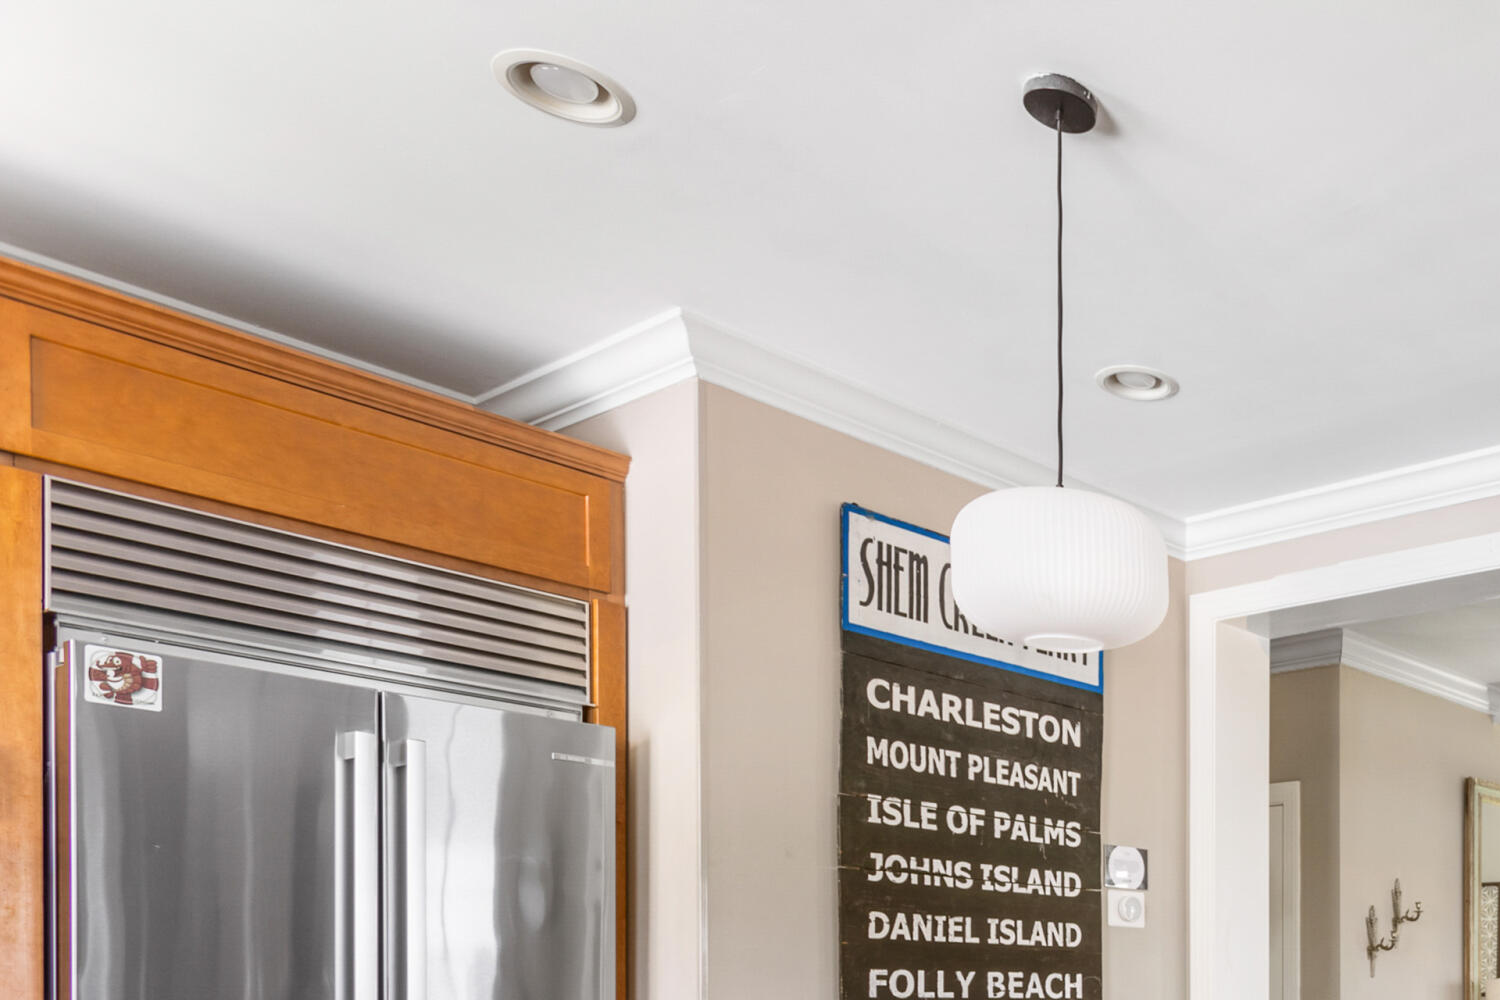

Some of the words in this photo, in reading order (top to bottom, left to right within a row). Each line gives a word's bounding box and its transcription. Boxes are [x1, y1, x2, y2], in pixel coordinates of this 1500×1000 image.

[859, 537, 928, 623] SHEM
[866, 678, 1081, 747] CHARLESTON
[866, 736, 961, 778] MOUNT
[968, 753, 1081, 797] PLEASANT
[867, 794, 938, 831] ISLE
[946, 805, 985, 836] OF
[993, 811, 1082, 847] PALMS
[867, 853, 974, 890] JOHNS
[980, 864, 1082, 898] ISLAND
[868, 911, 980, 944] DANIEL
[987, 918, 1082, 948] ISLAND
[868, 969, 976, 999] FOLLY
[987, 971, 1083, 1000] BEACH
